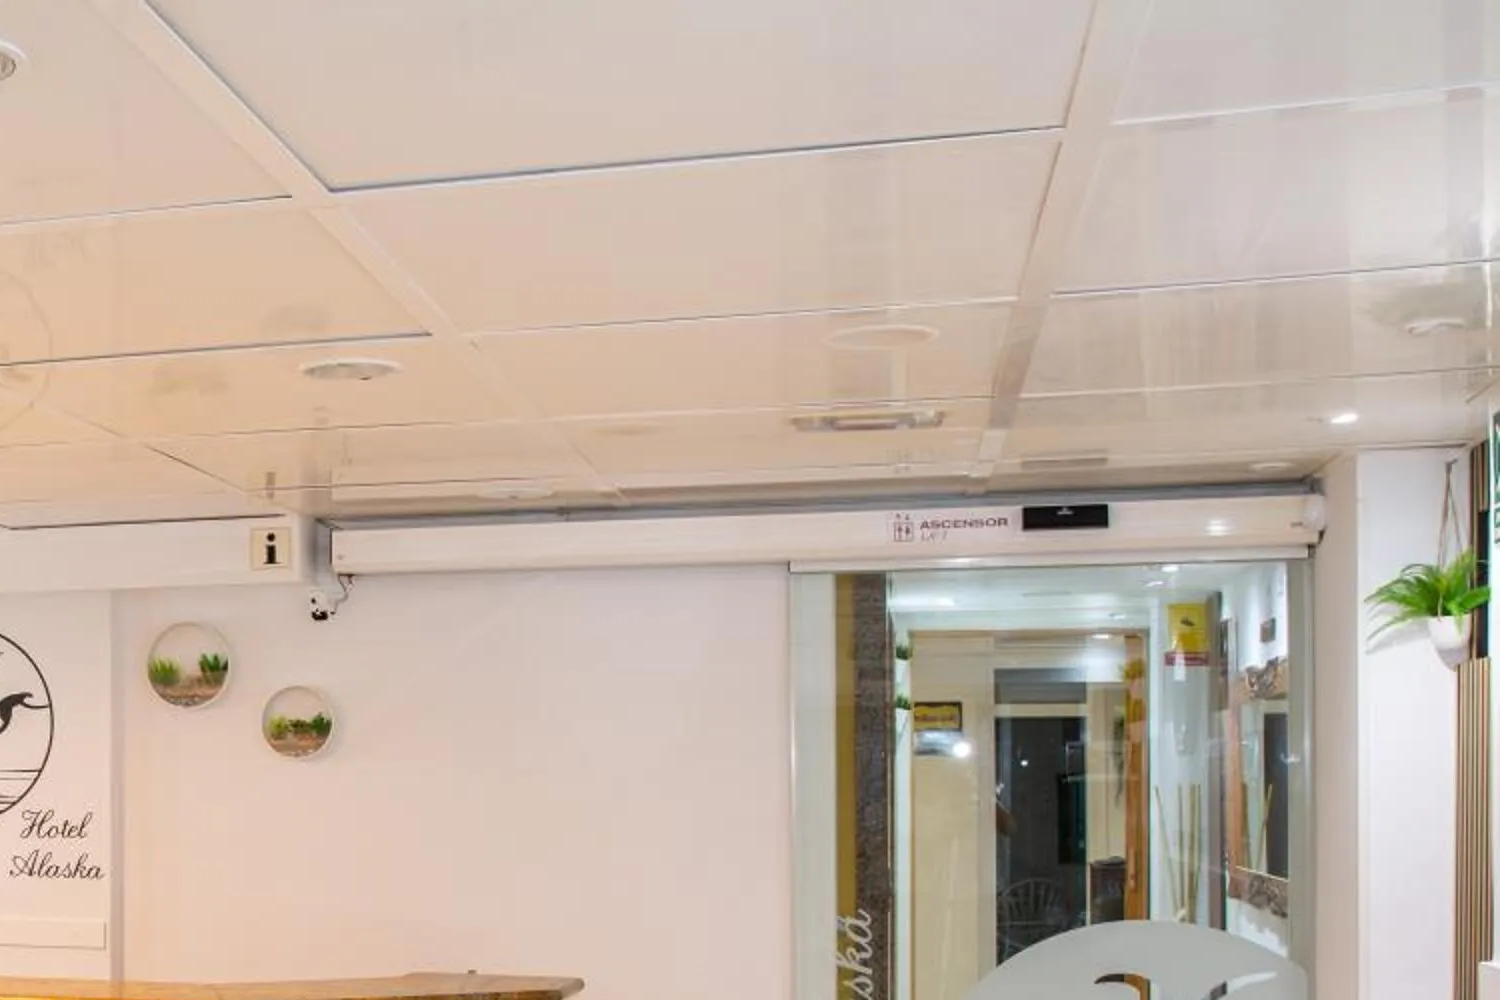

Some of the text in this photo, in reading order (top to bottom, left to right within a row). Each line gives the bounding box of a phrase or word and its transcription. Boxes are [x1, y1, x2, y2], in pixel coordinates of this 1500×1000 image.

[920, 517, 1008, 530] ASCENSOR
[20, 809, 93, 839] Hotel
[9, 849, 104, 881] Alaska
